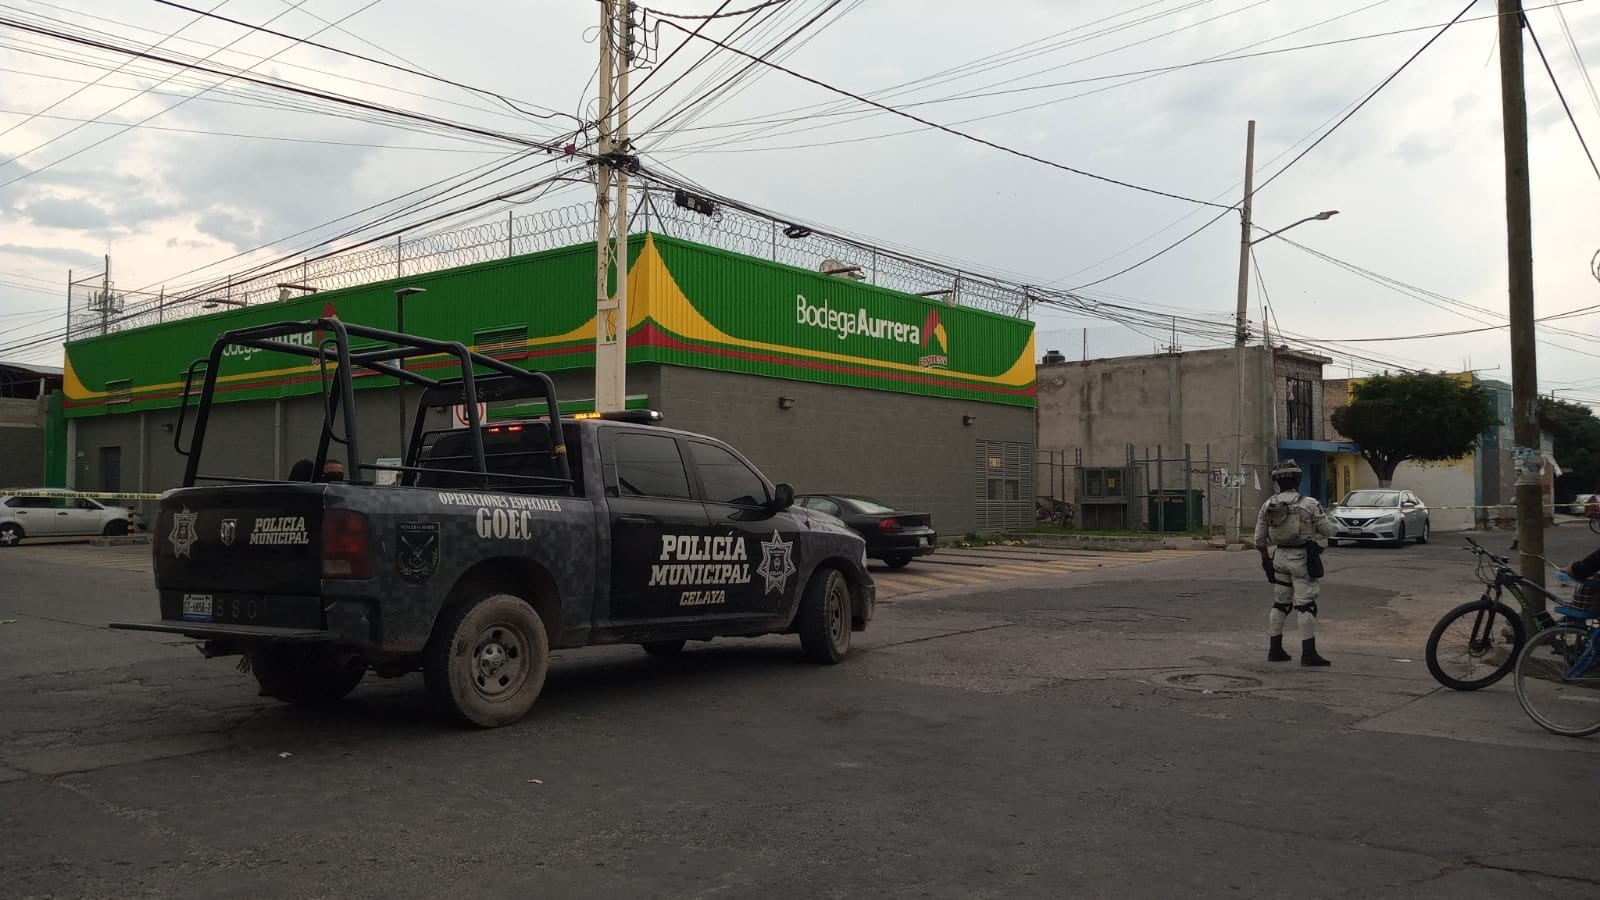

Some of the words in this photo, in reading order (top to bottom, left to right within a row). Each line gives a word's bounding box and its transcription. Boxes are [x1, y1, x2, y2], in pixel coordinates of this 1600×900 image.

[438, 492, 509, 508] OPERACIONES
[508, 496, 562, 512] ESPECIALES
[253, 516, 306, 533] POLICIA
[476, 507, 532, 541] GOEC
[249, 531, 309, 545] MUNICIPAL
[660, 530, 748, 561] POLICÍA
[648, 563, 752, 586] MUNICIPAL
[679, 590, 726, 606] CELAYA
